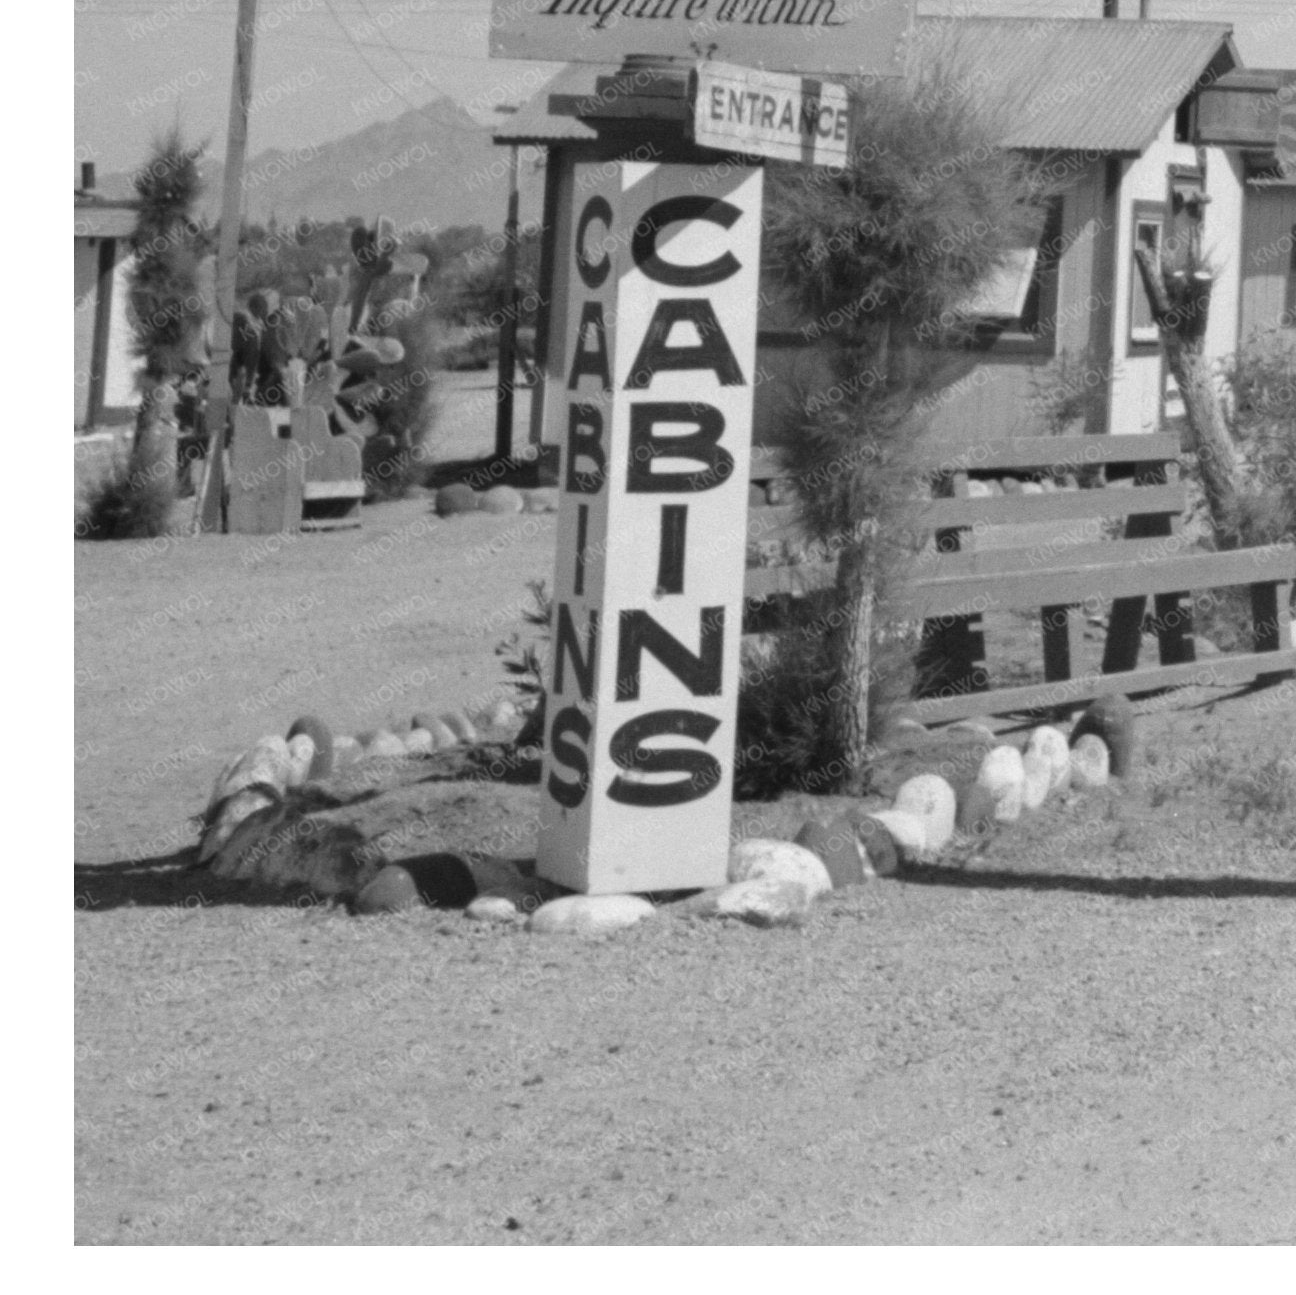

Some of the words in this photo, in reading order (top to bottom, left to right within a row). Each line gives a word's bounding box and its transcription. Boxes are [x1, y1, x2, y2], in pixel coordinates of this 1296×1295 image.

[709, 85, 848, 141] ENTRANCE
[549, 195, 614, 809] CABINS
[605, 194, 749, 809] CABINS
